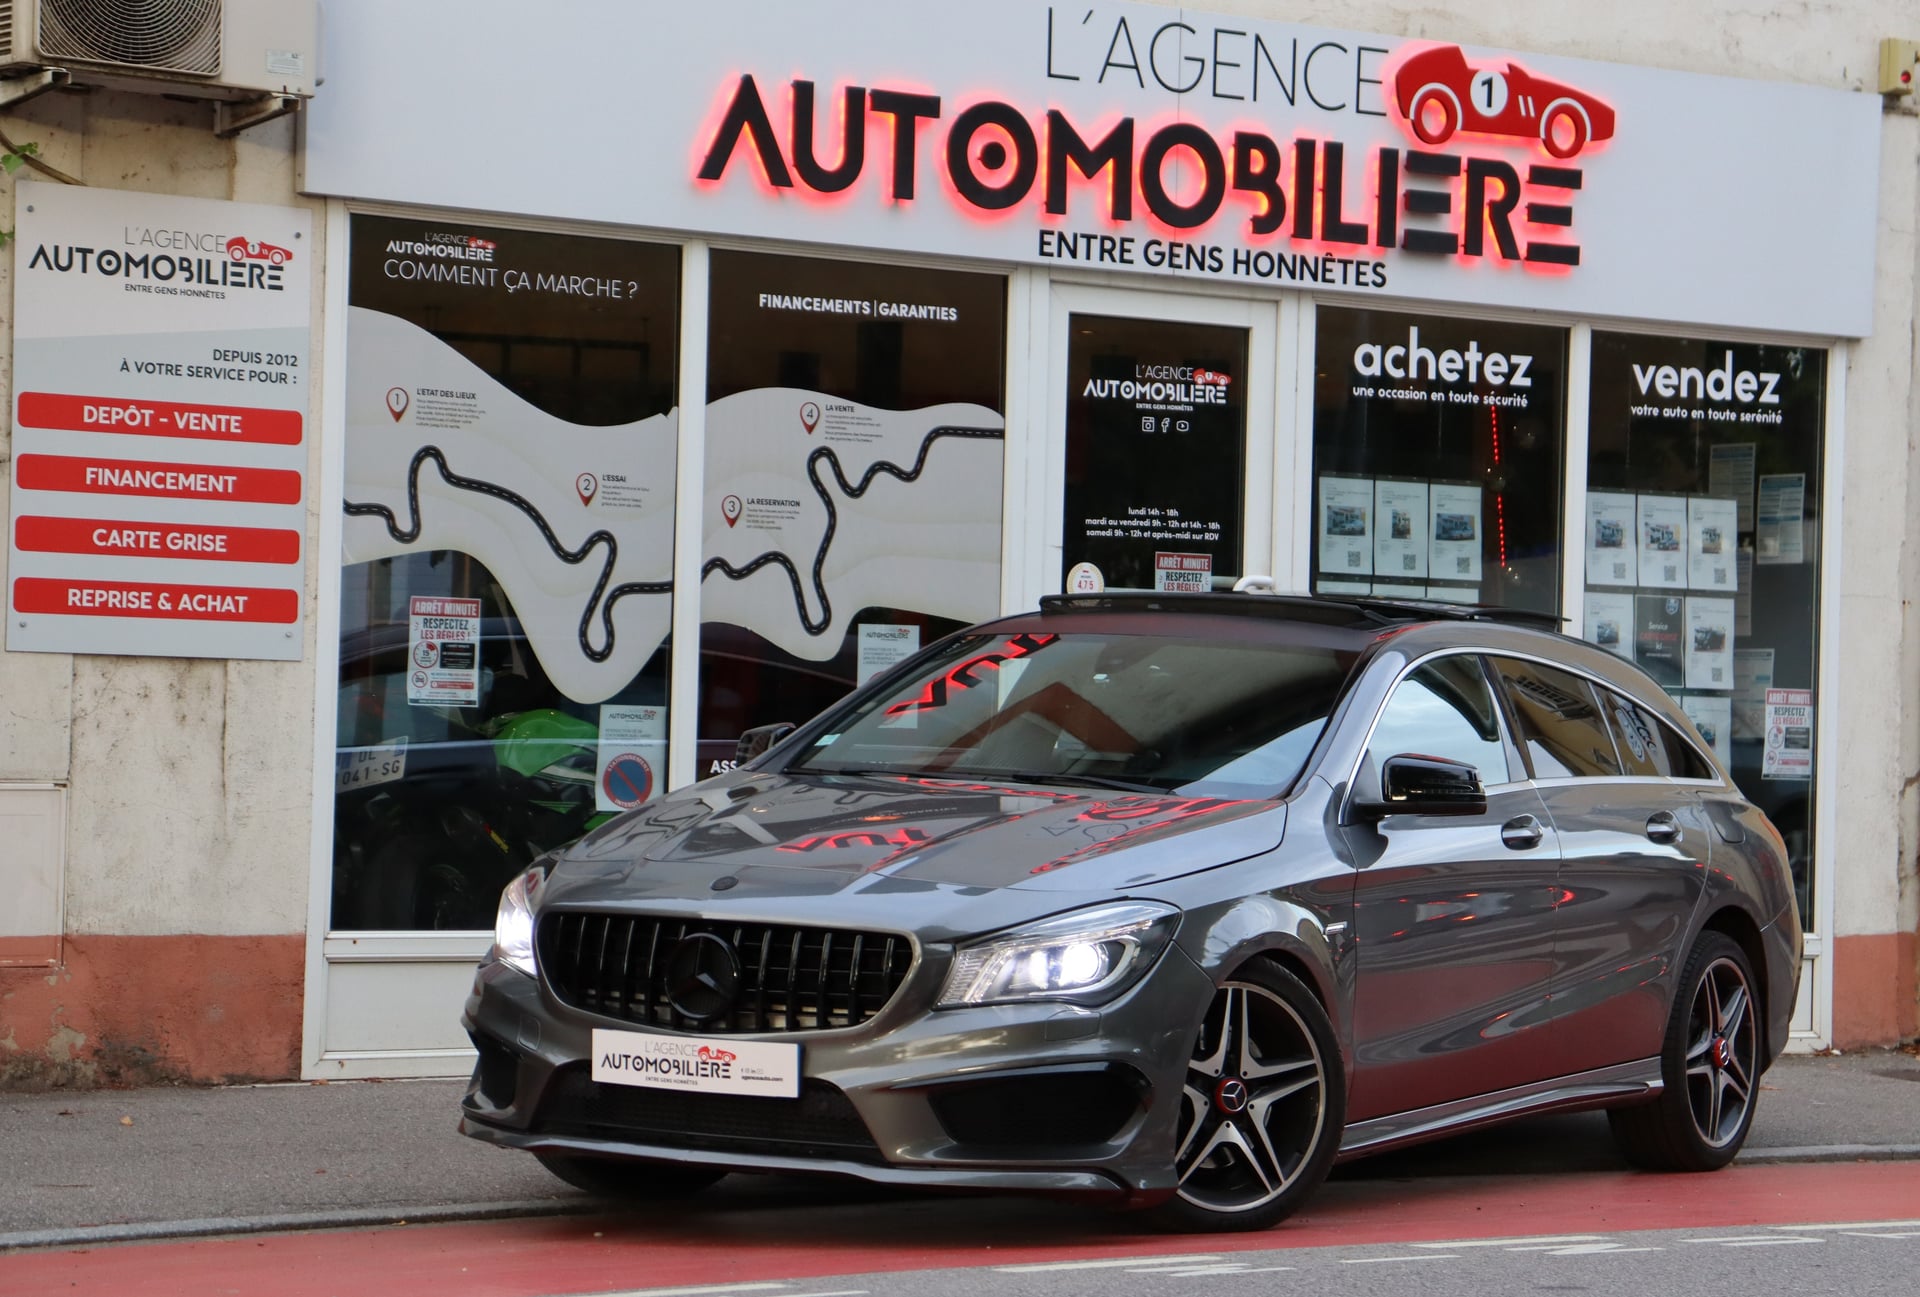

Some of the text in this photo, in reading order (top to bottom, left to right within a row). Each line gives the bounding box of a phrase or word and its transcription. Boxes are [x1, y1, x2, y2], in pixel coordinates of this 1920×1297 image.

[1046, 6, 1390, 118] L'AGENCE
[1479, 75, 1497, 109] 1
[124, 226, 227, 254] L'AGENCE
[424, 232, 469, 245] L'AGENCE
[1038, 229, 1388, 289] ENTRE GENS HONNÊTES
[384, 259, 638, 299] COMMENT ÇA MARCHE ?
[125, 283, 226, 299] ENTRE GENS HONNÊTES
[212, 348, 298, 367] DEPUIS 2012
[1353, 326, 1533, 387] achetez
[120, 357, 130, 373] À
[133, 361, 183, 376] VOTRE
[186, 365, 245, 381] SERVICE
[248, 369, 288, 384] POUR
[1136, 364, 1194, 381] L'AGENCE
[1632, 350, 1781, 403] vendez
[440, 390, 454, 398] DES
[455, 391, 477, 400] LIEUX
[1353, 386, 1528, 407] une occasion en toute sécurité
[806, 408, 814, 419] 4
[835, 405, 855, 413] VENTE
[1631, 405, 1783, 424] votre auto en toute serénité
[83, 402, 154, 427] DEPÔT
[173, 411, 242, 433] VENTE
[85, 467, 237, 493] FINANCEMENT
[583, 478, 591, 491] 2
[728, 500, 736, 513] 3
[756, 499, 800, 507] RESERVATION
[1128, 507, 1146, 515] lundi
[1148, 508, 1160, 516] 14h
[1166, 508, 1179, 517] 18h
[1085, 517, 1107, 525] mardi
[1118, 518, 1151, 527] vendredi
[1152, 519, 1161, 527] 9h
[1168, 520, 1180, 528] 12h
[1189, 520, 1201, 529] 14h
[1208, 521, 1220, 530] 18h
[92, 528, 227, 552] CARTE GRISE
[1086, 528, 1112, 537] samedi
[1114, 529, 1124, 537] 9h
[1130, 529, 1142, 538] 12h
[1143, 530, 1151, 538] et
[1152, 530, 1191, 540] après-midi
[1204, 532, 1219, 541] RDV
[1159, 555, 1209, 570] ARRÊT MINUTE
[1165, 571, 1203, 583] RESPECTEZ
[1164, 582, 1175, 591] LES
[67, 588, 247, 613] REPRISE & ACHAT
[415, 600, 477, 616] ARRÊT MINUTE
[423, 617, 469, 630] RESPECTEZ
[421, 629, 434, 640] LES
[1774, 706, 1806, 717] RESPECTEZ
[644, 1040, 699, 1057] L'AGENCE
